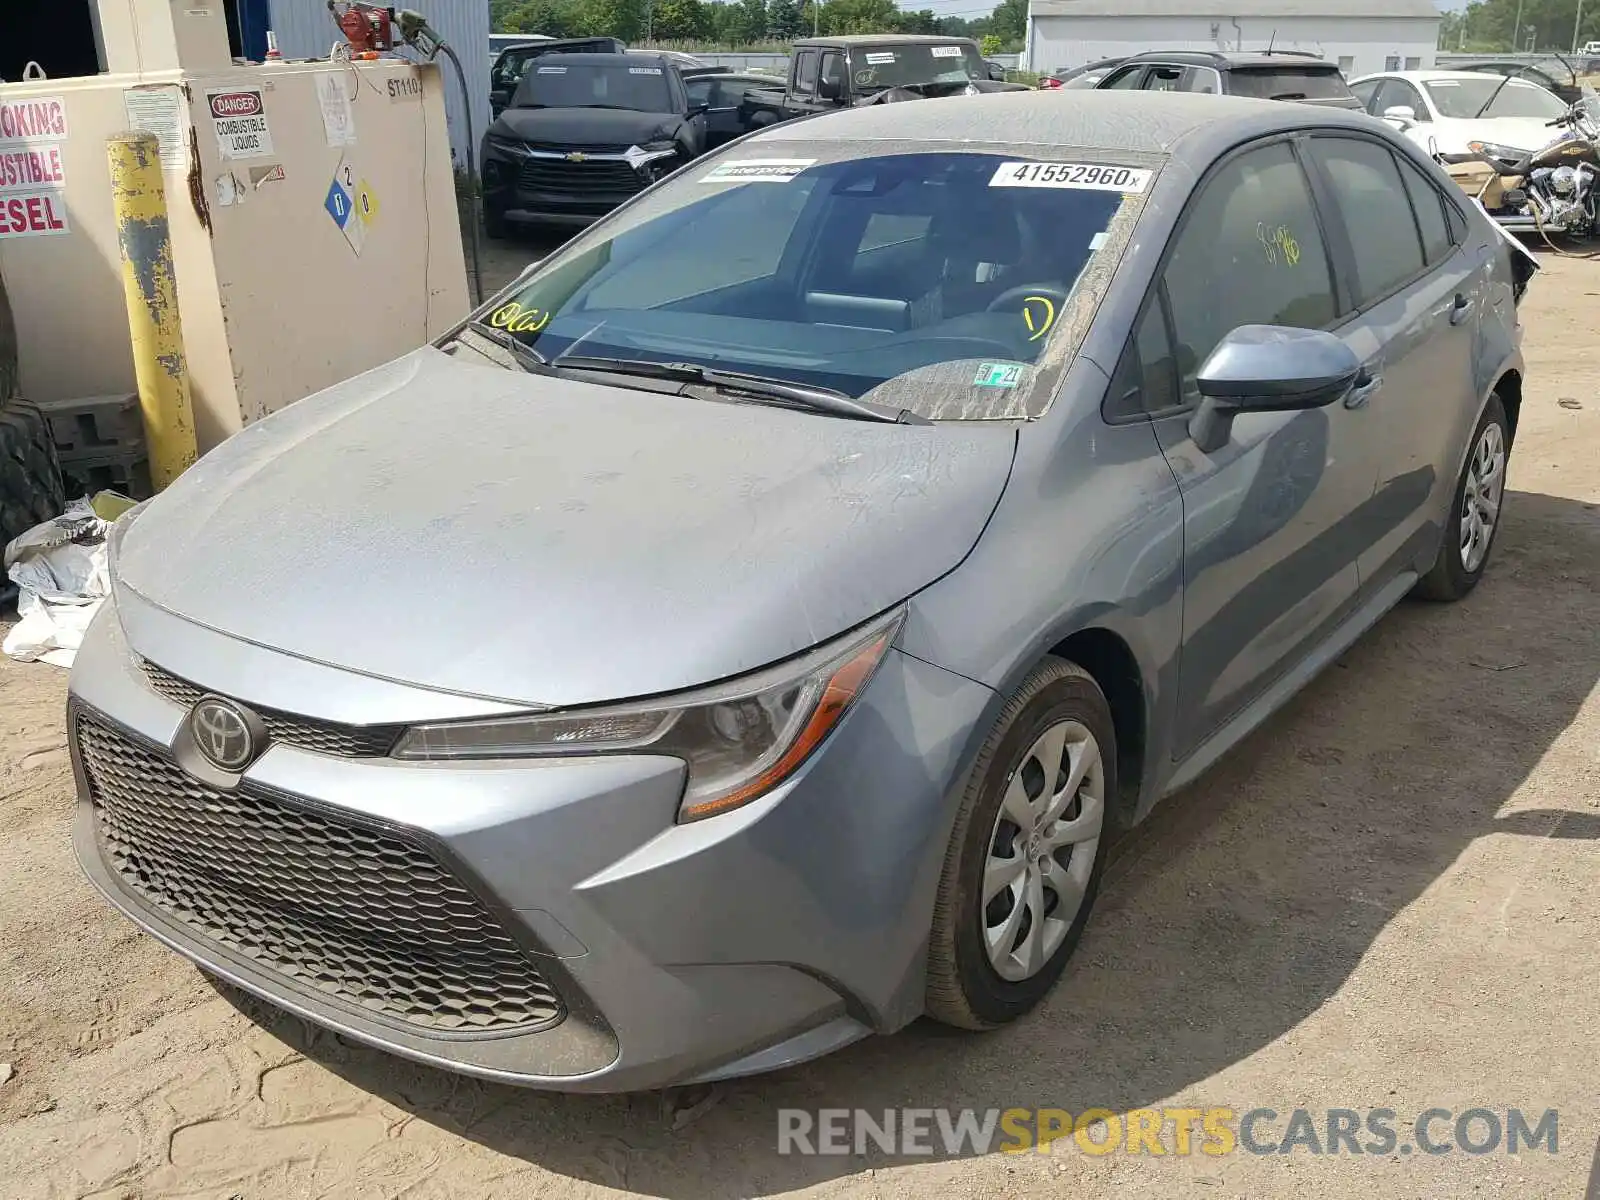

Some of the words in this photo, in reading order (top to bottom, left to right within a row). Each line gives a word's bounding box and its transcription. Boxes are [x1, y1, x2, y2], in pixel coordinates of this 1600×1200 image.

[217, 97, 255, 112] DANGER
[0, 101, 65, 137] OKING
[216, 117, 266, 136] COMBUSTIBLE
[231, 134, 260, 150] LIQUIDS
[344, 166, 353, 187] 2
[335, 193, 344, 216] 1
[360, 193, 370, 214] 0
[1003, 367, 1020, 382] 21
